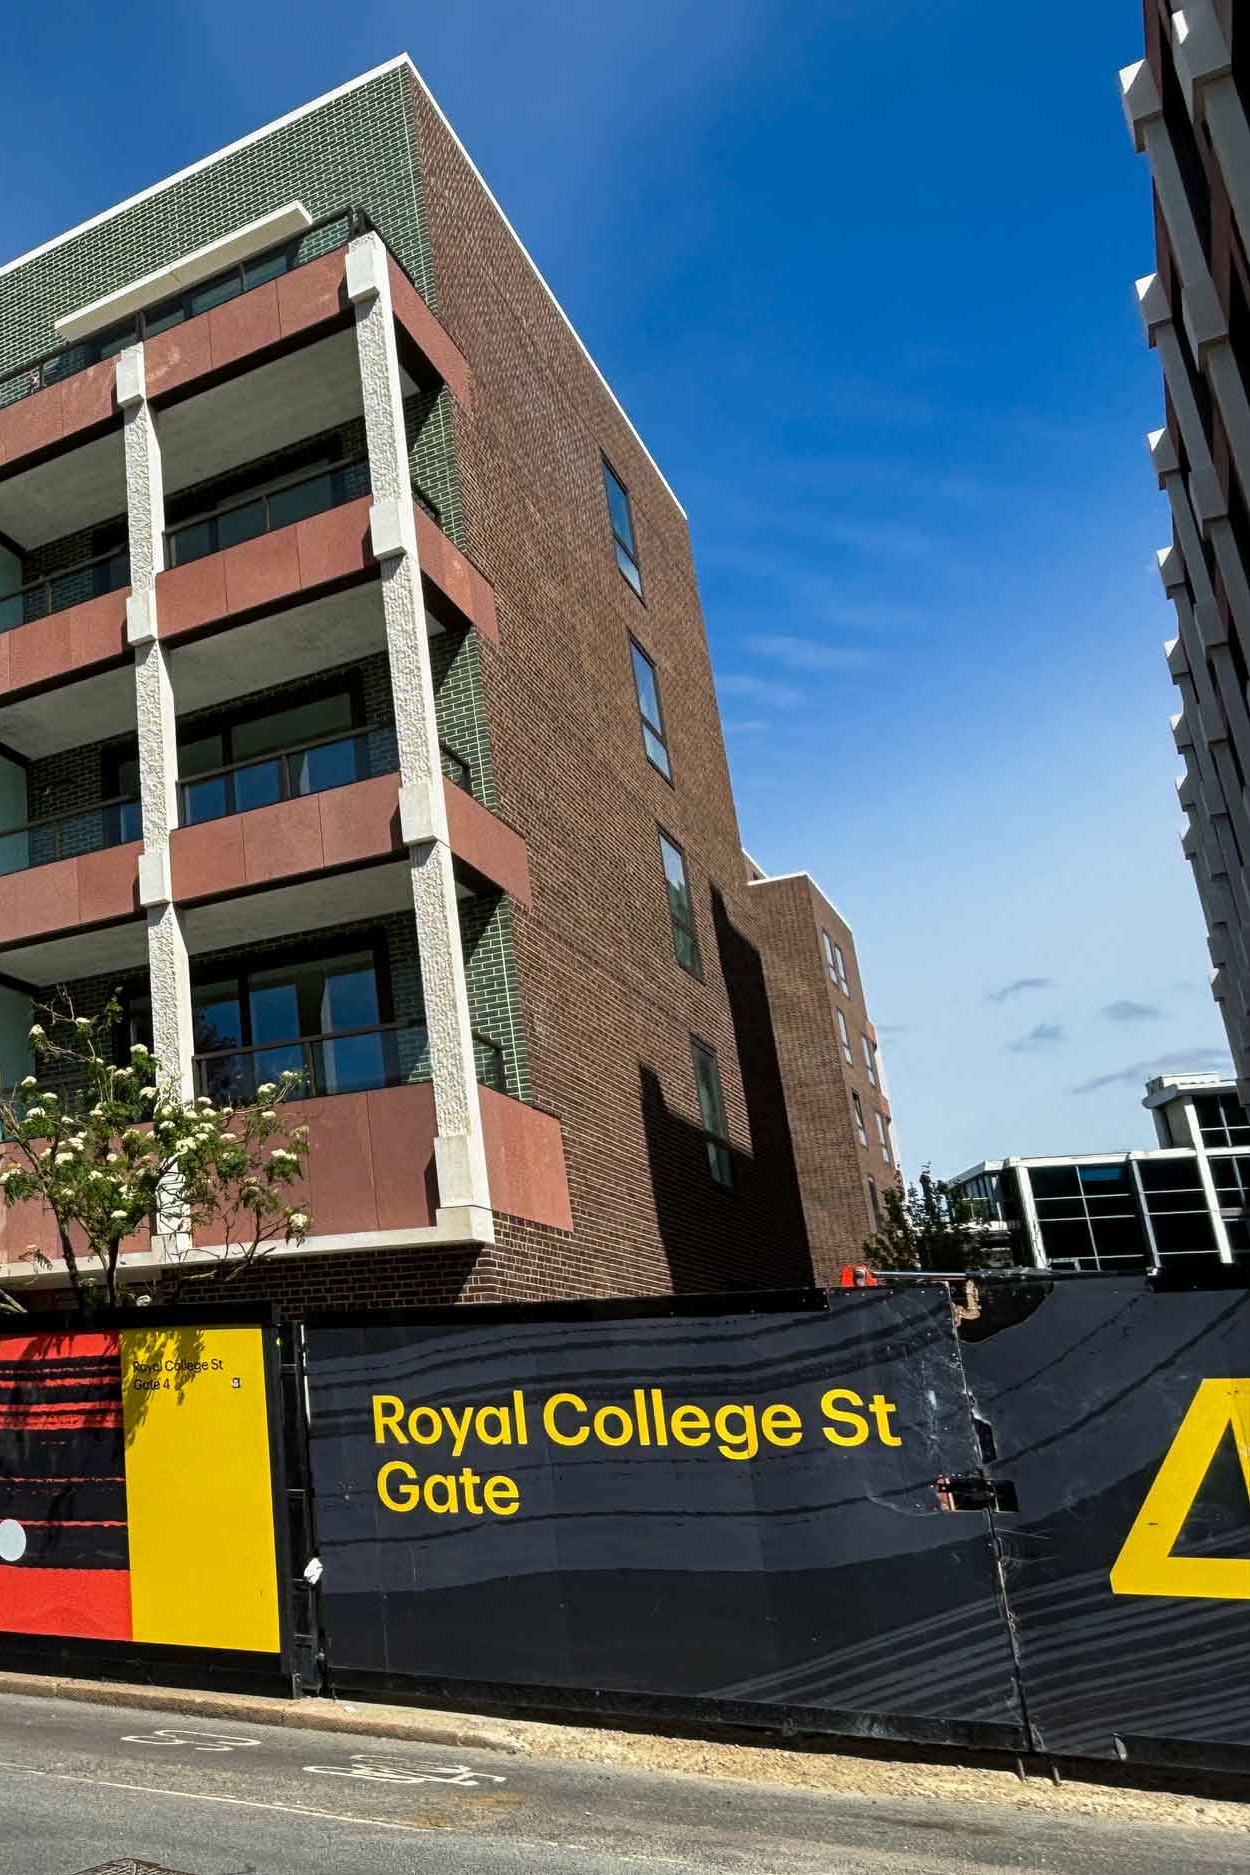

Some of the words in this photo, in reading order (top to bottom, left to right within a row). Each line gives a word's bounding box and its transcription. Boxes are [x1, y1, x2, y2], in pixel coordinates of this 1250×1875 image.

[133, 1361, 162, 1374] Royal
[165, 1359, 209, 1373] College
[211, 1358, 223, 1371] St
[134, 1379, 161, 1390] Gate
[163, 1378, 170, 1390] 4
[372, 1390, 528, 1456] Royal
[543, 1389, 802, 1461] College
[820, 1389, 902, 1447] St
[377, 1461, 520, 1516] Gate
